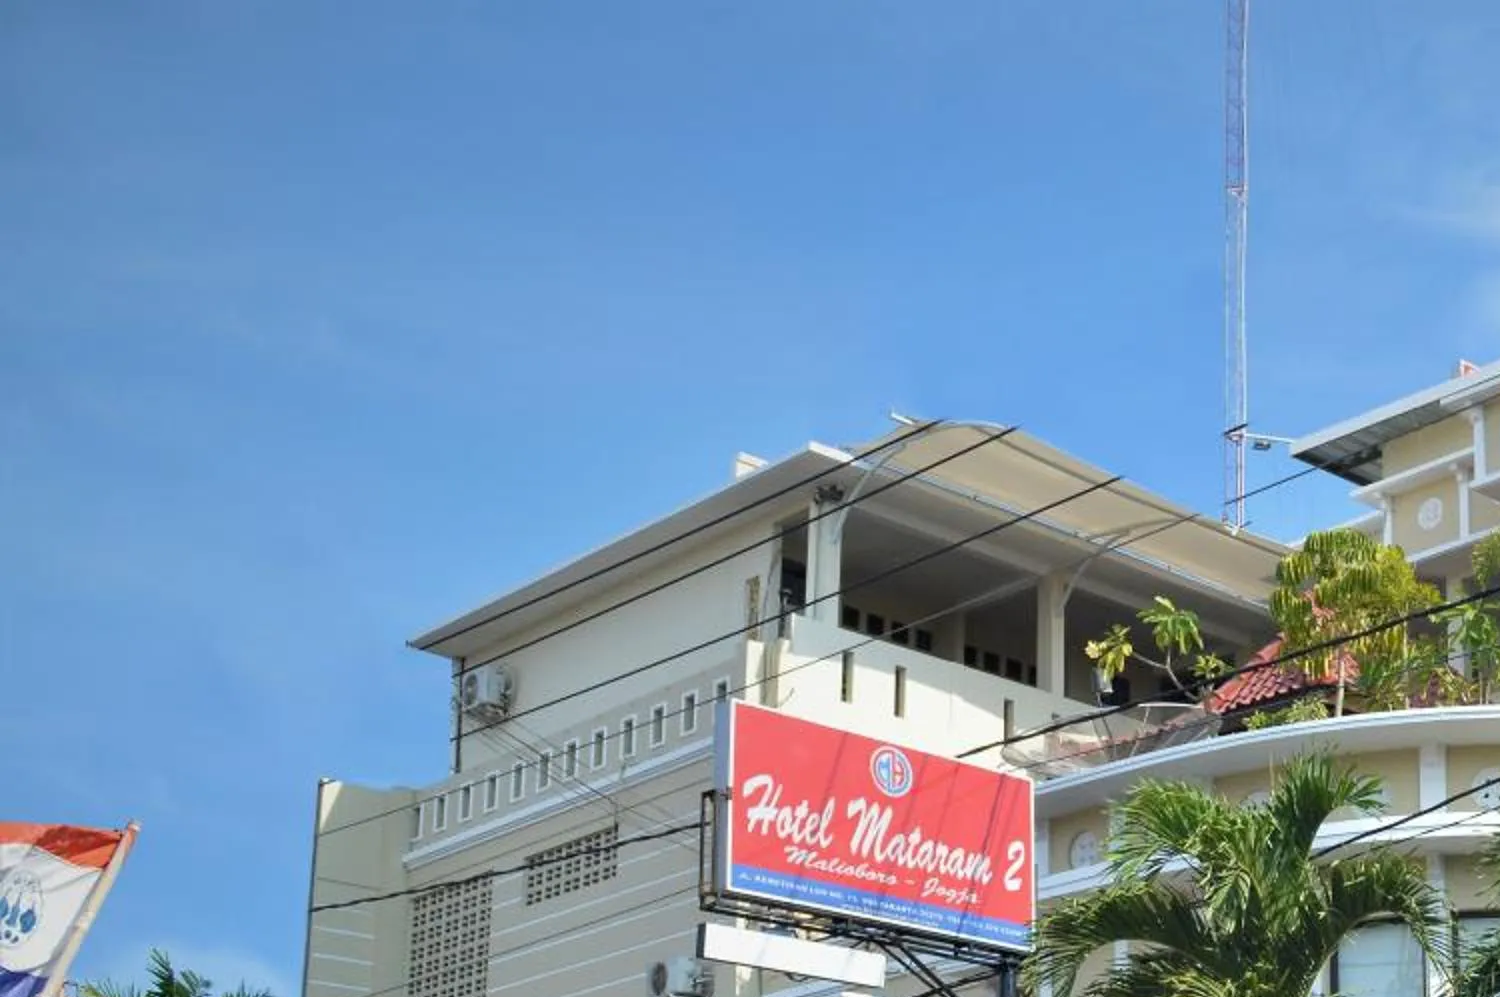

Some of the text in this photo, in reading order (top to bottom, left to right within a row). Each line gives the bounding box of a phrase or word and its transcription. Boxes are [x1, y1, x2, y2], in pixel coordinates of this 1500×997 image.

[743, 774, 1025, 891] Hotel Mataram 2
[784, 846, 896, 885] Malioboro
